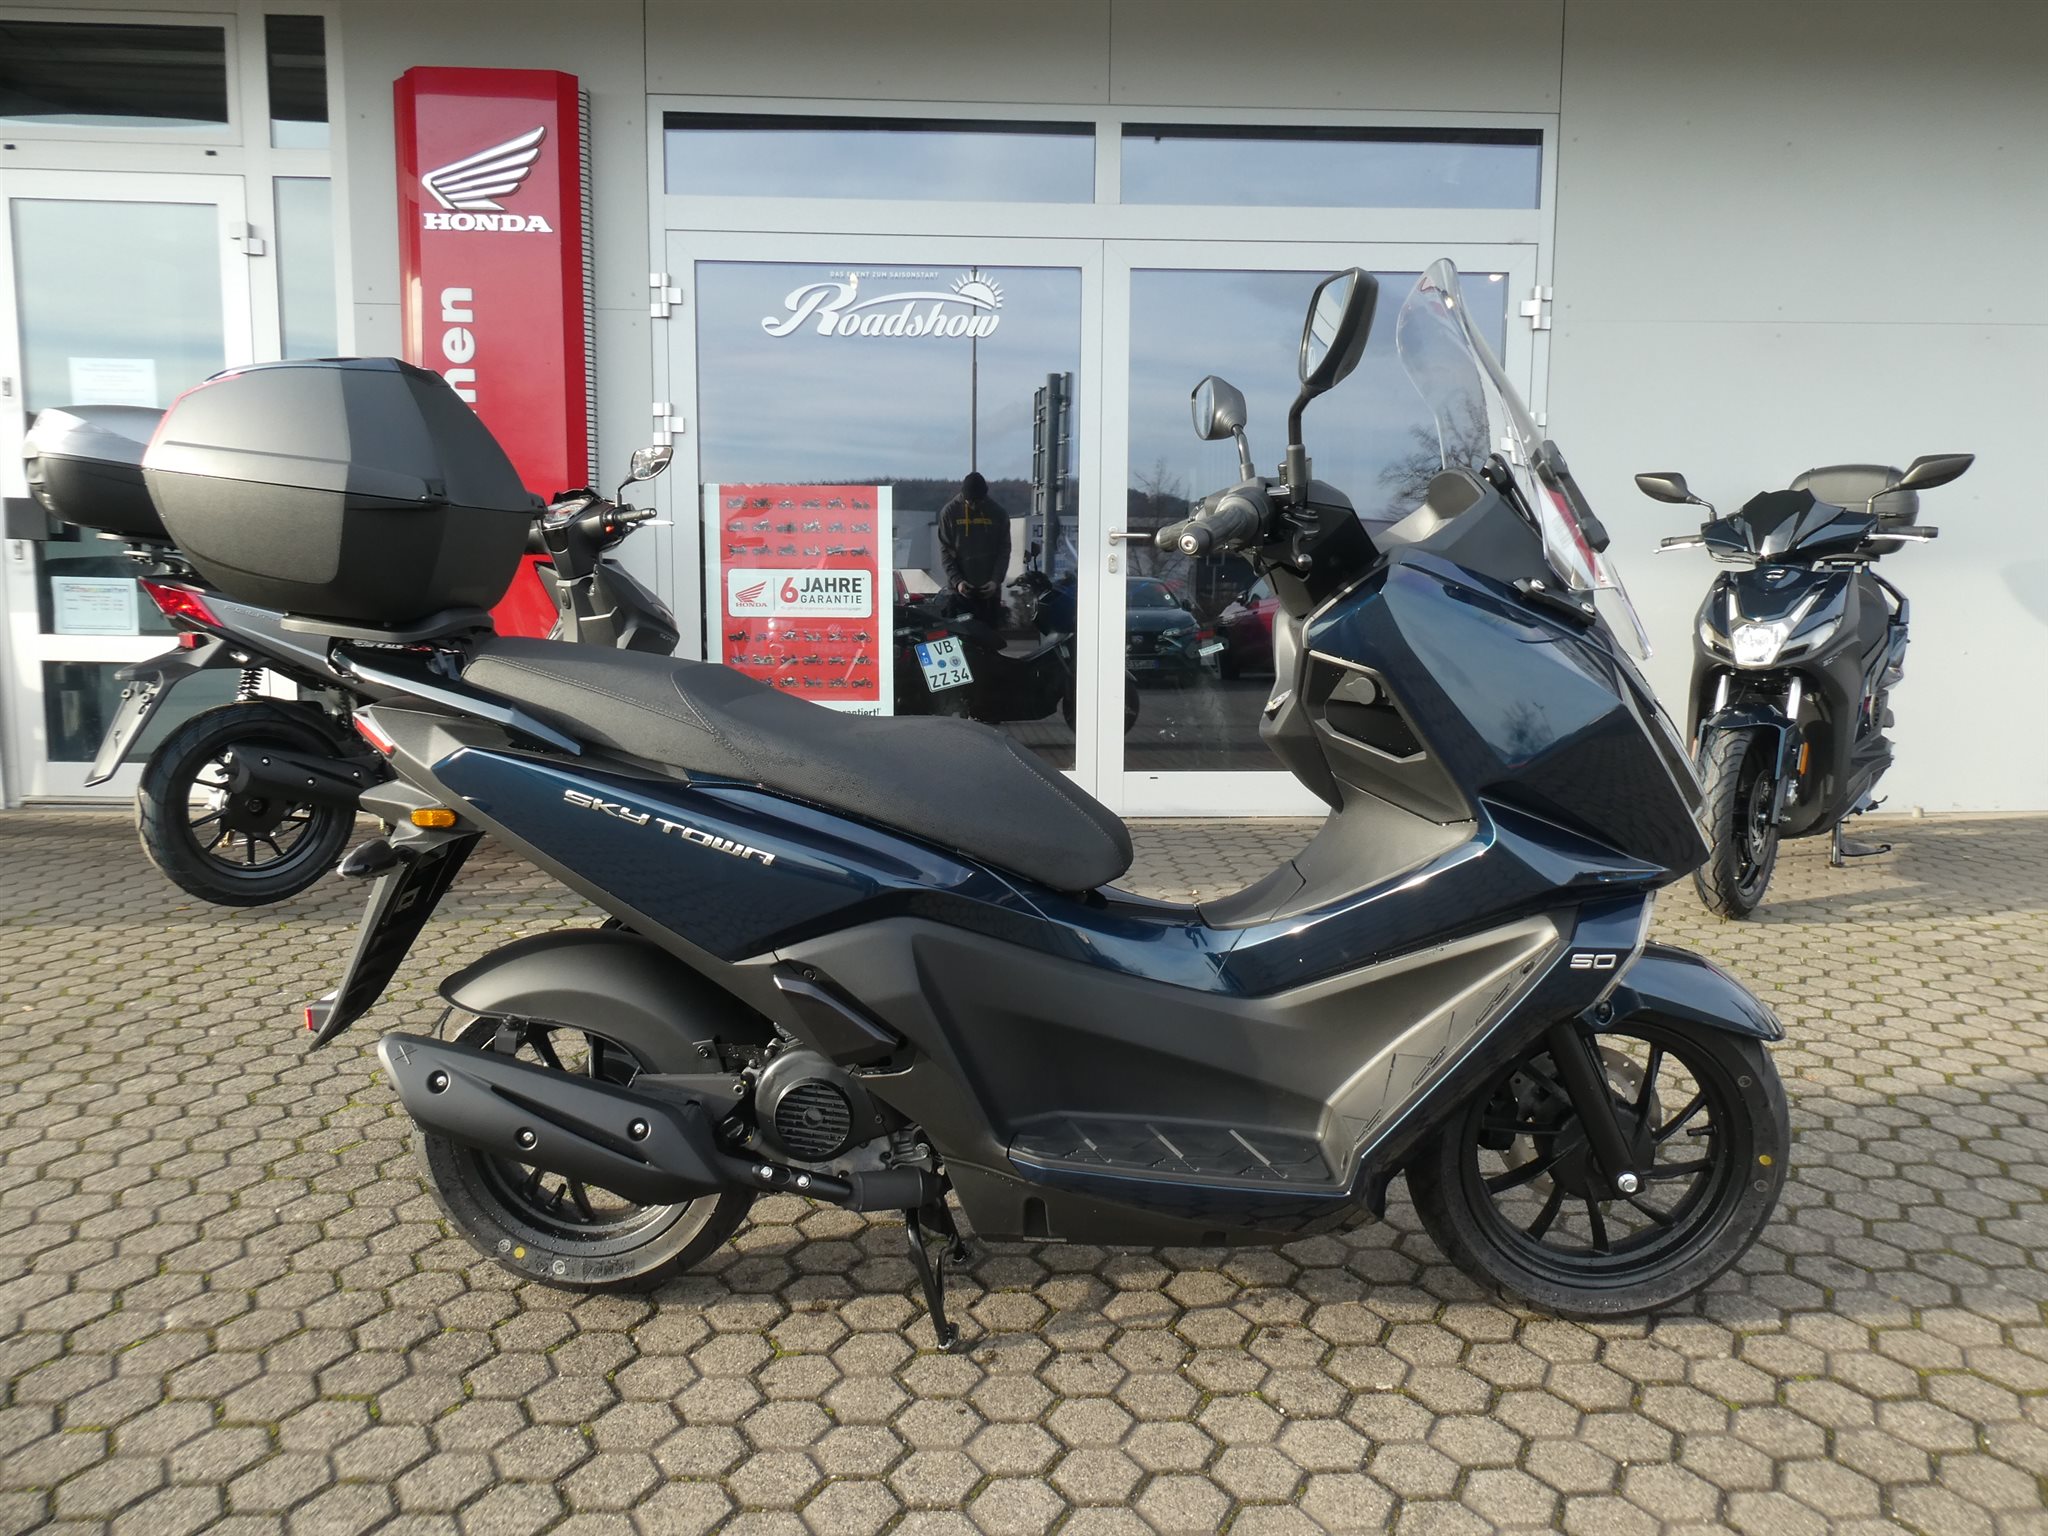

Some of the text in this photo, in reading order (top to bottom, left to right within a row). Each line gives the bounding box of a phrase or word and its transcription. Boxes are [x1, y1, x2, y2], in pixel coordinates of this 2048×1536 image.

[424, 212, 553, 232] HONDA
[830, 270, 844, 278] DAS
[872, 271, 887, 279] ZUM
[890, 271, 939, 279] SAISONSTART
[761, 282, 1000, 338] Roadshow
[440, 286, 477, 404] nen
[780, 577, 862, 603] 6 JAHRE
[800, 595, 862, 604] GARANTIE
[933, 640, 954, 655] VB
[929, 667, 970, 688] ZZ 34
[1569, 953, 1617, 969] 50
